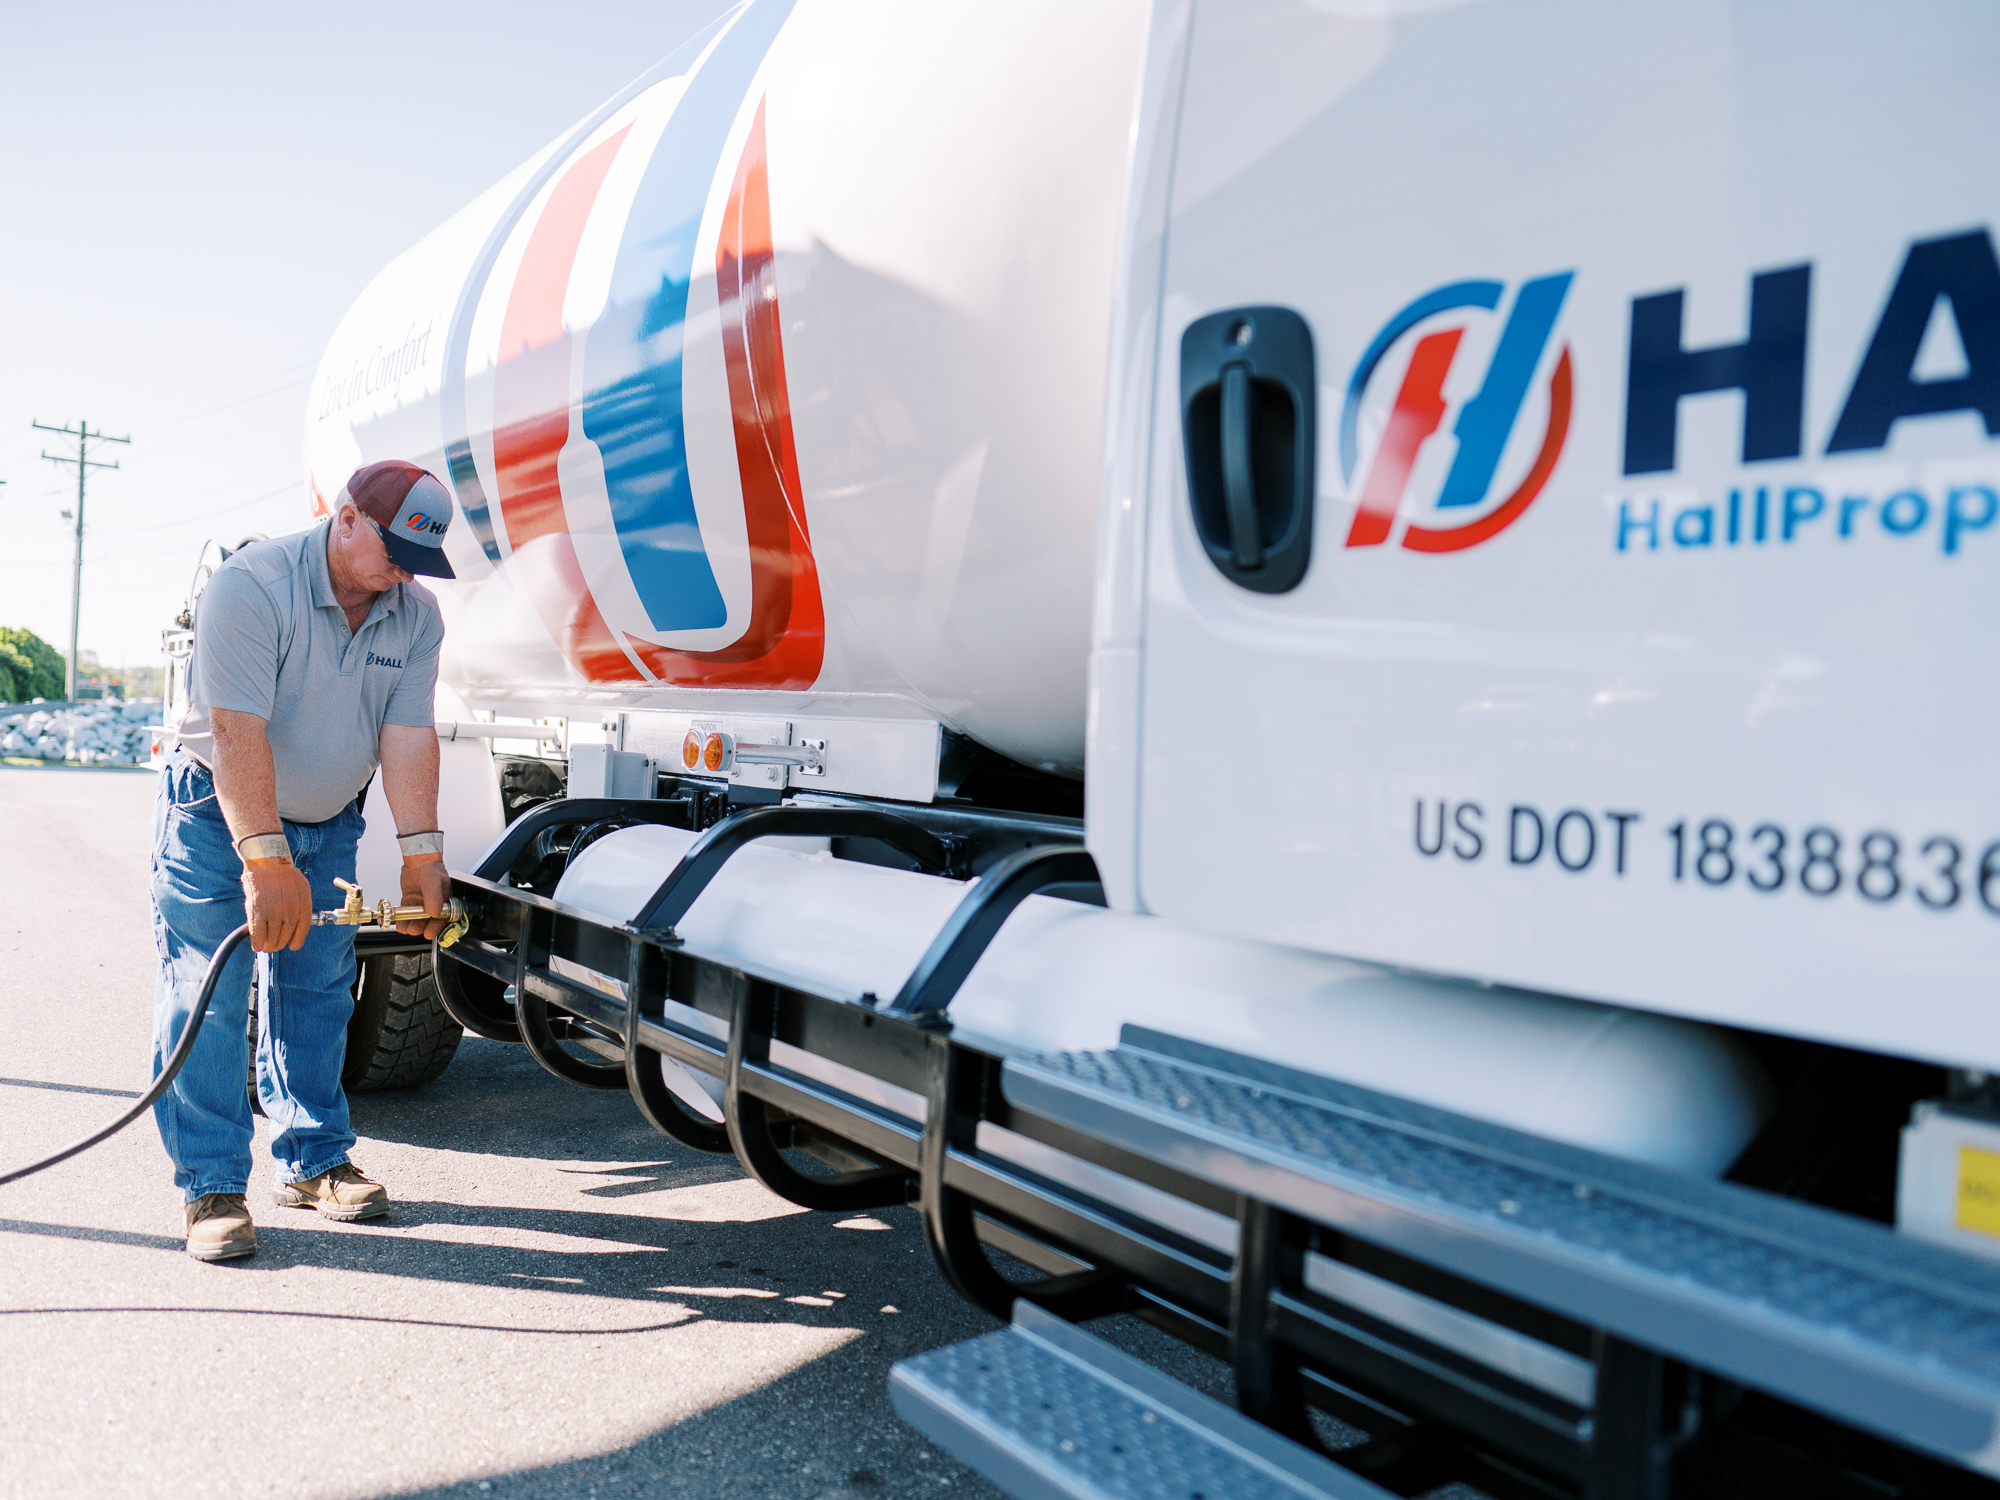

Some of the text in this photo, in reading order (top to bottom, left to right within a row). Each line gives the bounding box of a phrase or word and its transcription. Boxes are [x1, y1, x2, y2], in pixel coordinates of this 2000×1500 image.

[319, 318, 433, 421] Live In Comfort
[1616, 484, 1999, 556] HallProp
[375, 656, 403, 668] HALL
[1415, 799, 1483, 861] US
[1510, 806, 1640, 875] DOT
